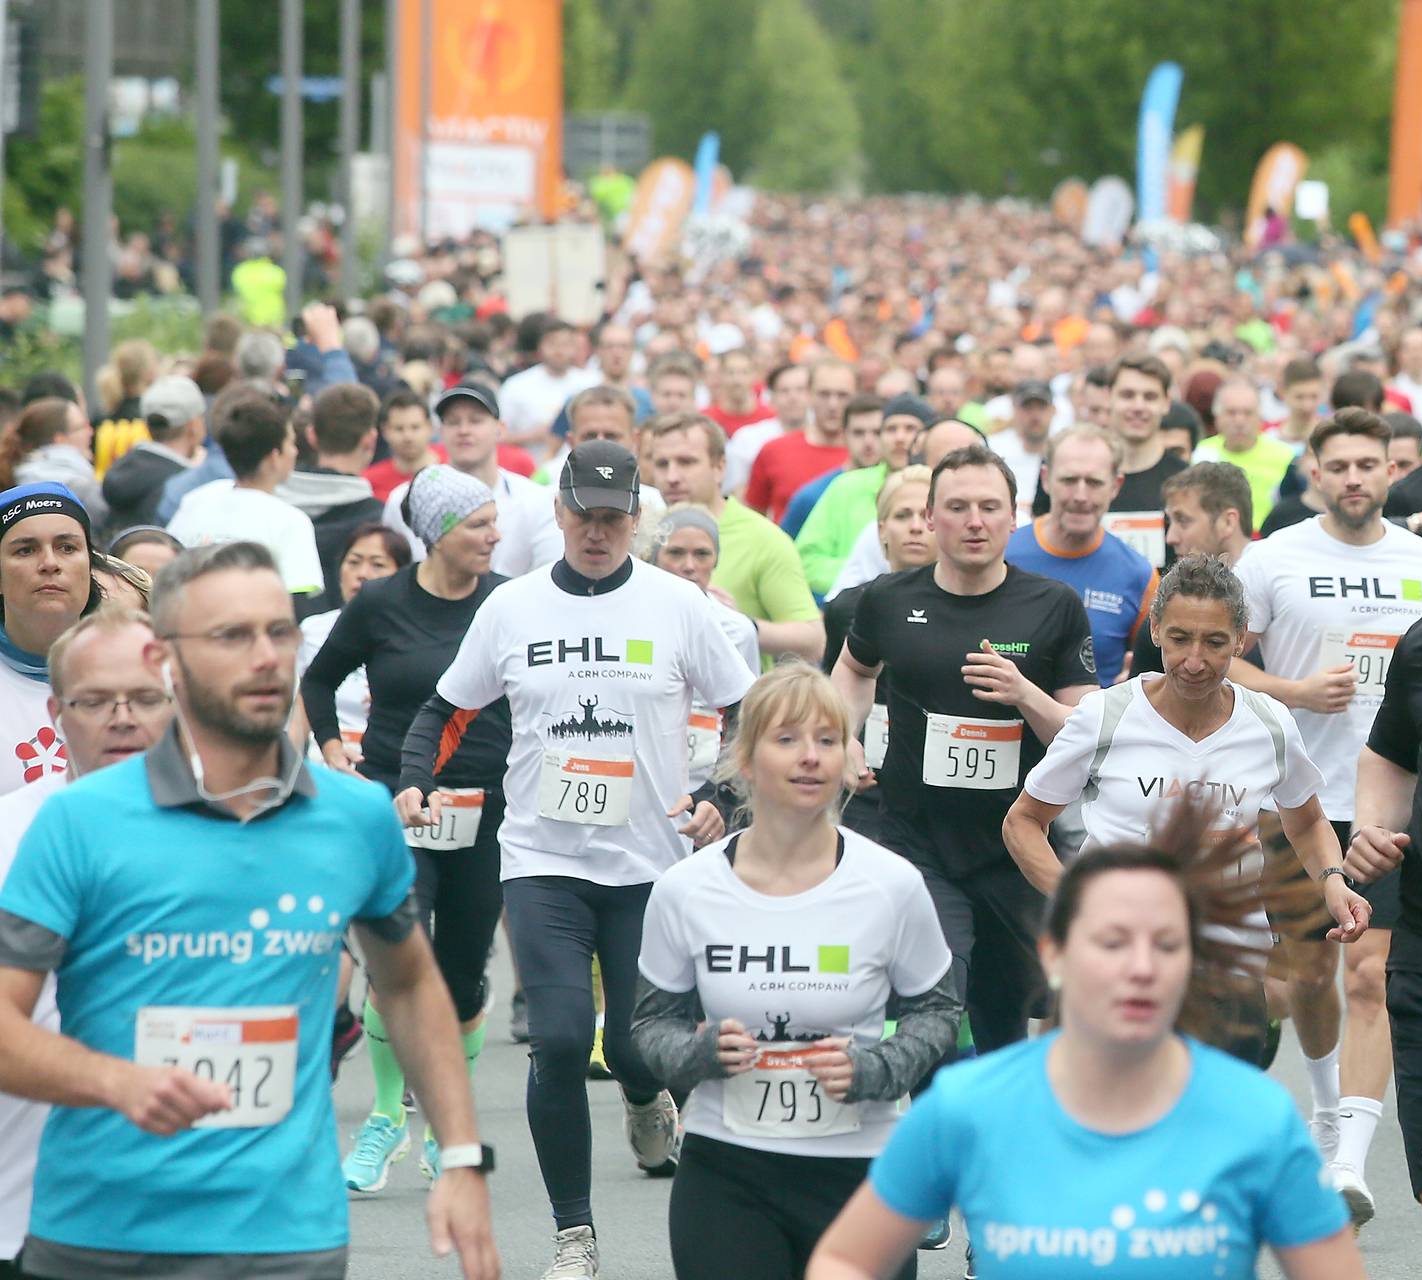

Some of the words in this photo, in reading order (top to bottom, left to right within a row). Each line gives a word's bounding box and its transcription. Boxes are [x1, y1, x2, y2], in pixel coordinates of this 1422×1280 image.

[2, 504, 22, 524] RSC
[26, 500, 62, 511] Moers
[1309, 576, 1397, 599] EHL
[527, 636, 620, 667] EHL
[979, 642, 1030, 653] CossHIT
[569, 671, 575, 679] A
[577, 671, 599, 679] CRH
[601, 669, 653, 681] COMPANY
[960, 728, 988, 738] Dennis
[946, 746, 997, 780] 595
[558, 780, 608, 815] 789
[126, 931, 254, 964] sprung
[263, 930, 334, 957] zwe
[705, 945, 810, 973] EHL
[749, 983, 756, 991] A
[760, 982, 785, 991] CRH
[788, 982, 849, 993] COMPANY
[163, 1056, 273, 1108] 42
[755, 1080, 822, 1123] 793
[984, 1223, 1116, 1267] sprung
